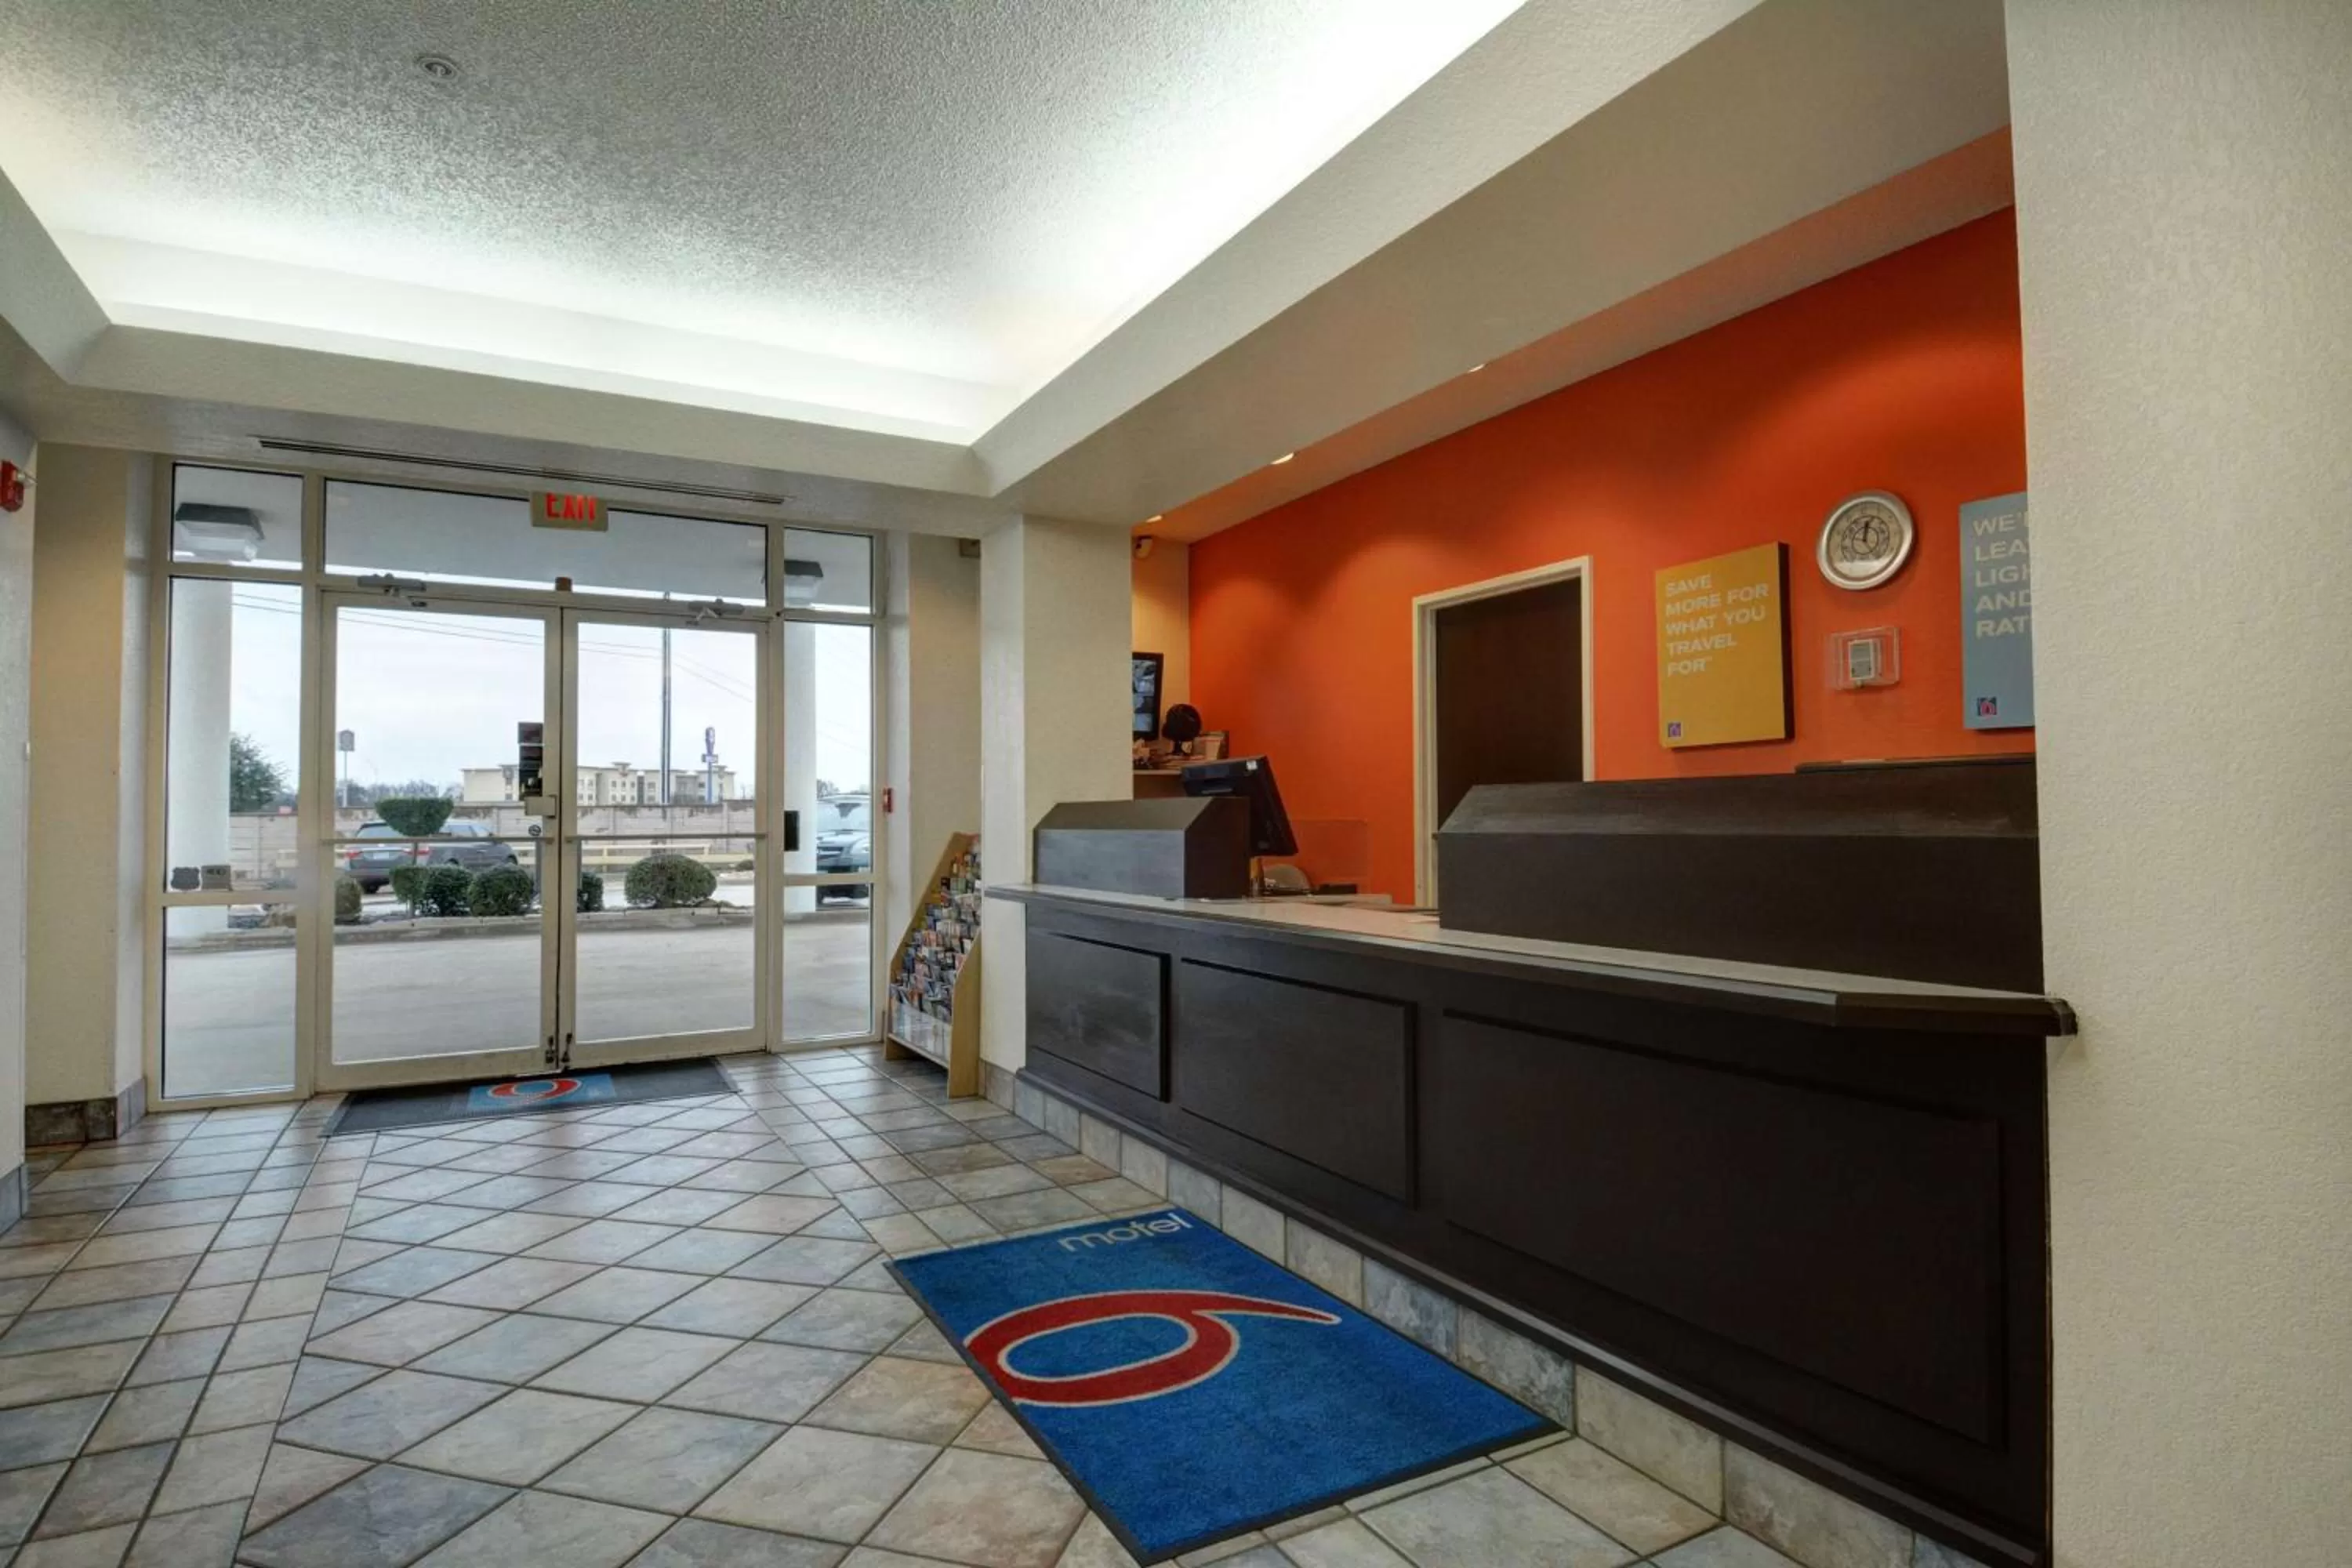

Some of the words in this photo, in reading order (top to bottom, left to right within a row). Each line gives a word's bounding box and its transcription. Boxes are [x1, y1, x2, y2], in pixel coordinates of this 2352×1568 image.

[1975, 538, 2030, 561] LEA
[1665, 574, 1712, 597] SAVE
[1666, 593, 1721, 618] MORE
[1727, 583, 1769, 604] FOR
[1666, 615, 1716, 635] WHAT
[1724, 605, 1766, 626] YOU
[1976, 615, 2031, 639] RAT
[1667, 633, 1737, 658] TRAVEL
[1058, 1212, 1193, 1252] motel
[963, 1290, 1342, 1406] 6
